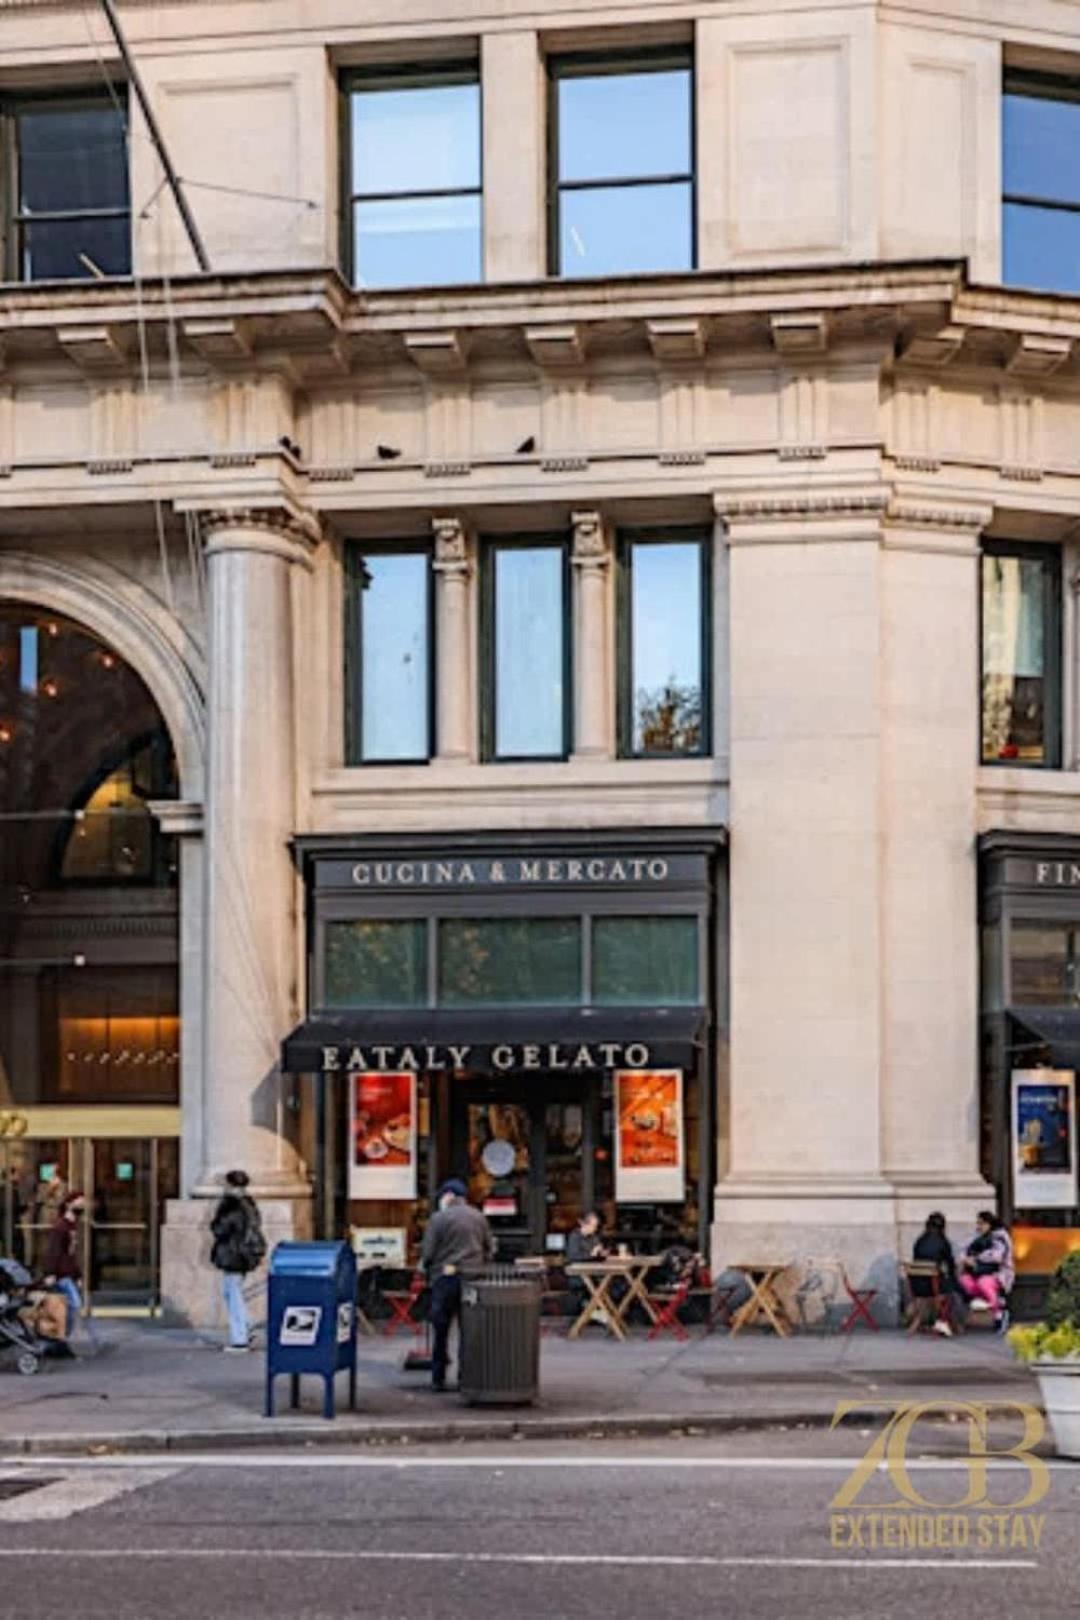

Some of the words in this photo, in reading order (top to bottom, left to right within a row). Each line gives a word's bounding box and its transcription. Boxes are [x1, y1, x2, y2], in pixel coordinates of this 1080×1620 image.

[352, 862, 475, 885] CUCINA
[490, 860, 506, 882] &
[519, 858, 669, 881] MERCATO
[322, 1045, 471, 1071] EATALY
[491, 1043, 650, 1069] GELATO
